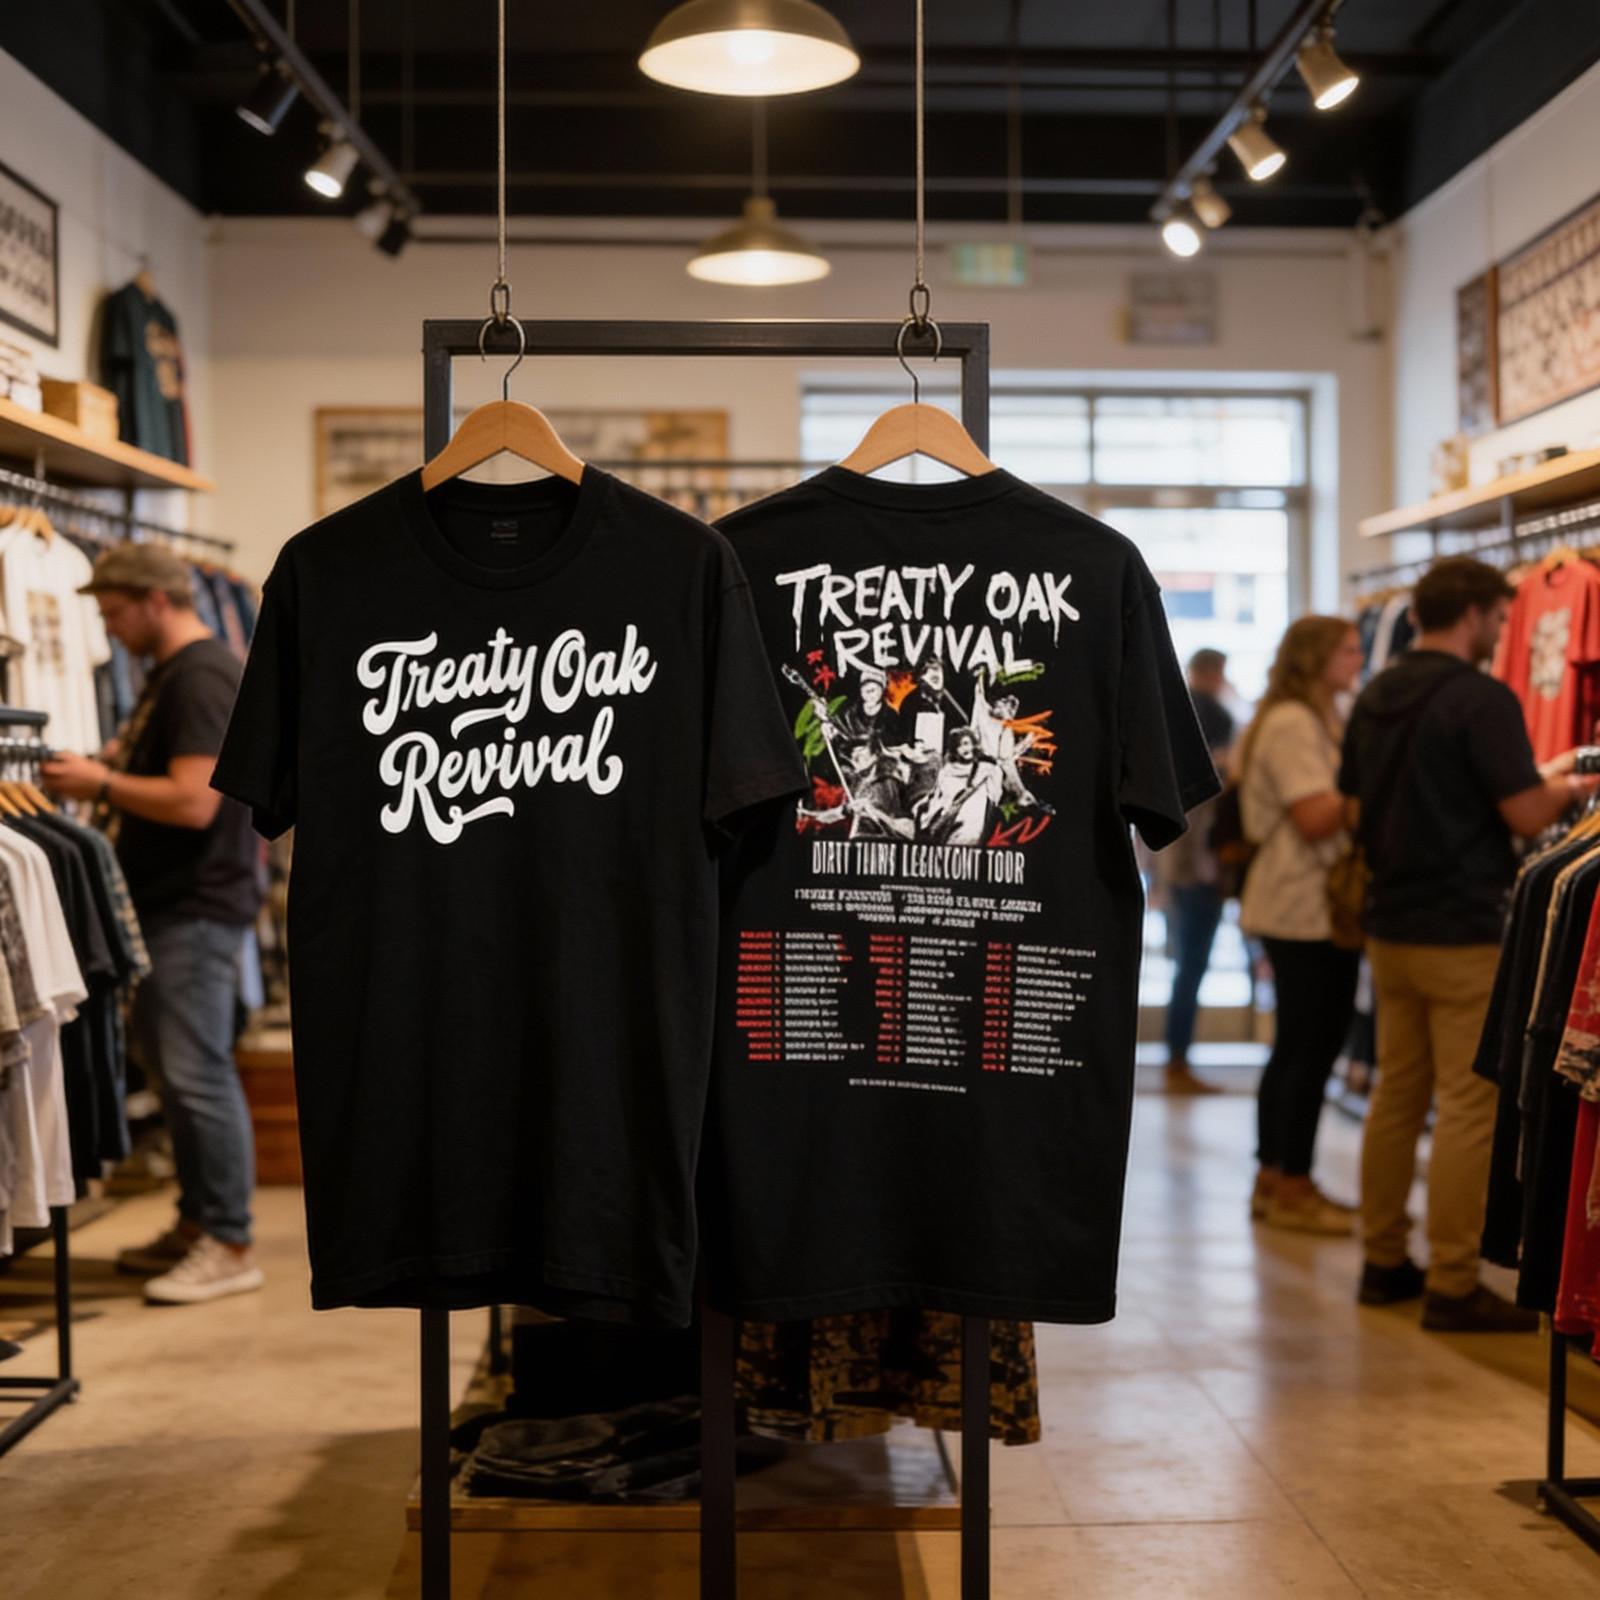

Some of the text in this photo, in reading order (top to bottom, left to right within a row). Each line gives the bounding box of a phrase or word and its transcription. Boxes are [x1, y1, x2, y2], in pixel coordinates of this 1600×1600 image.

[775, 564, 1080, 649] TREATY OAK
[357, 624, 657, 740] Treaty Oak
[833, 622, 1033, 682] REVIVAL
[379, 706, 624, 844] Revival
[986, 849, 1025, 885] TOUR
